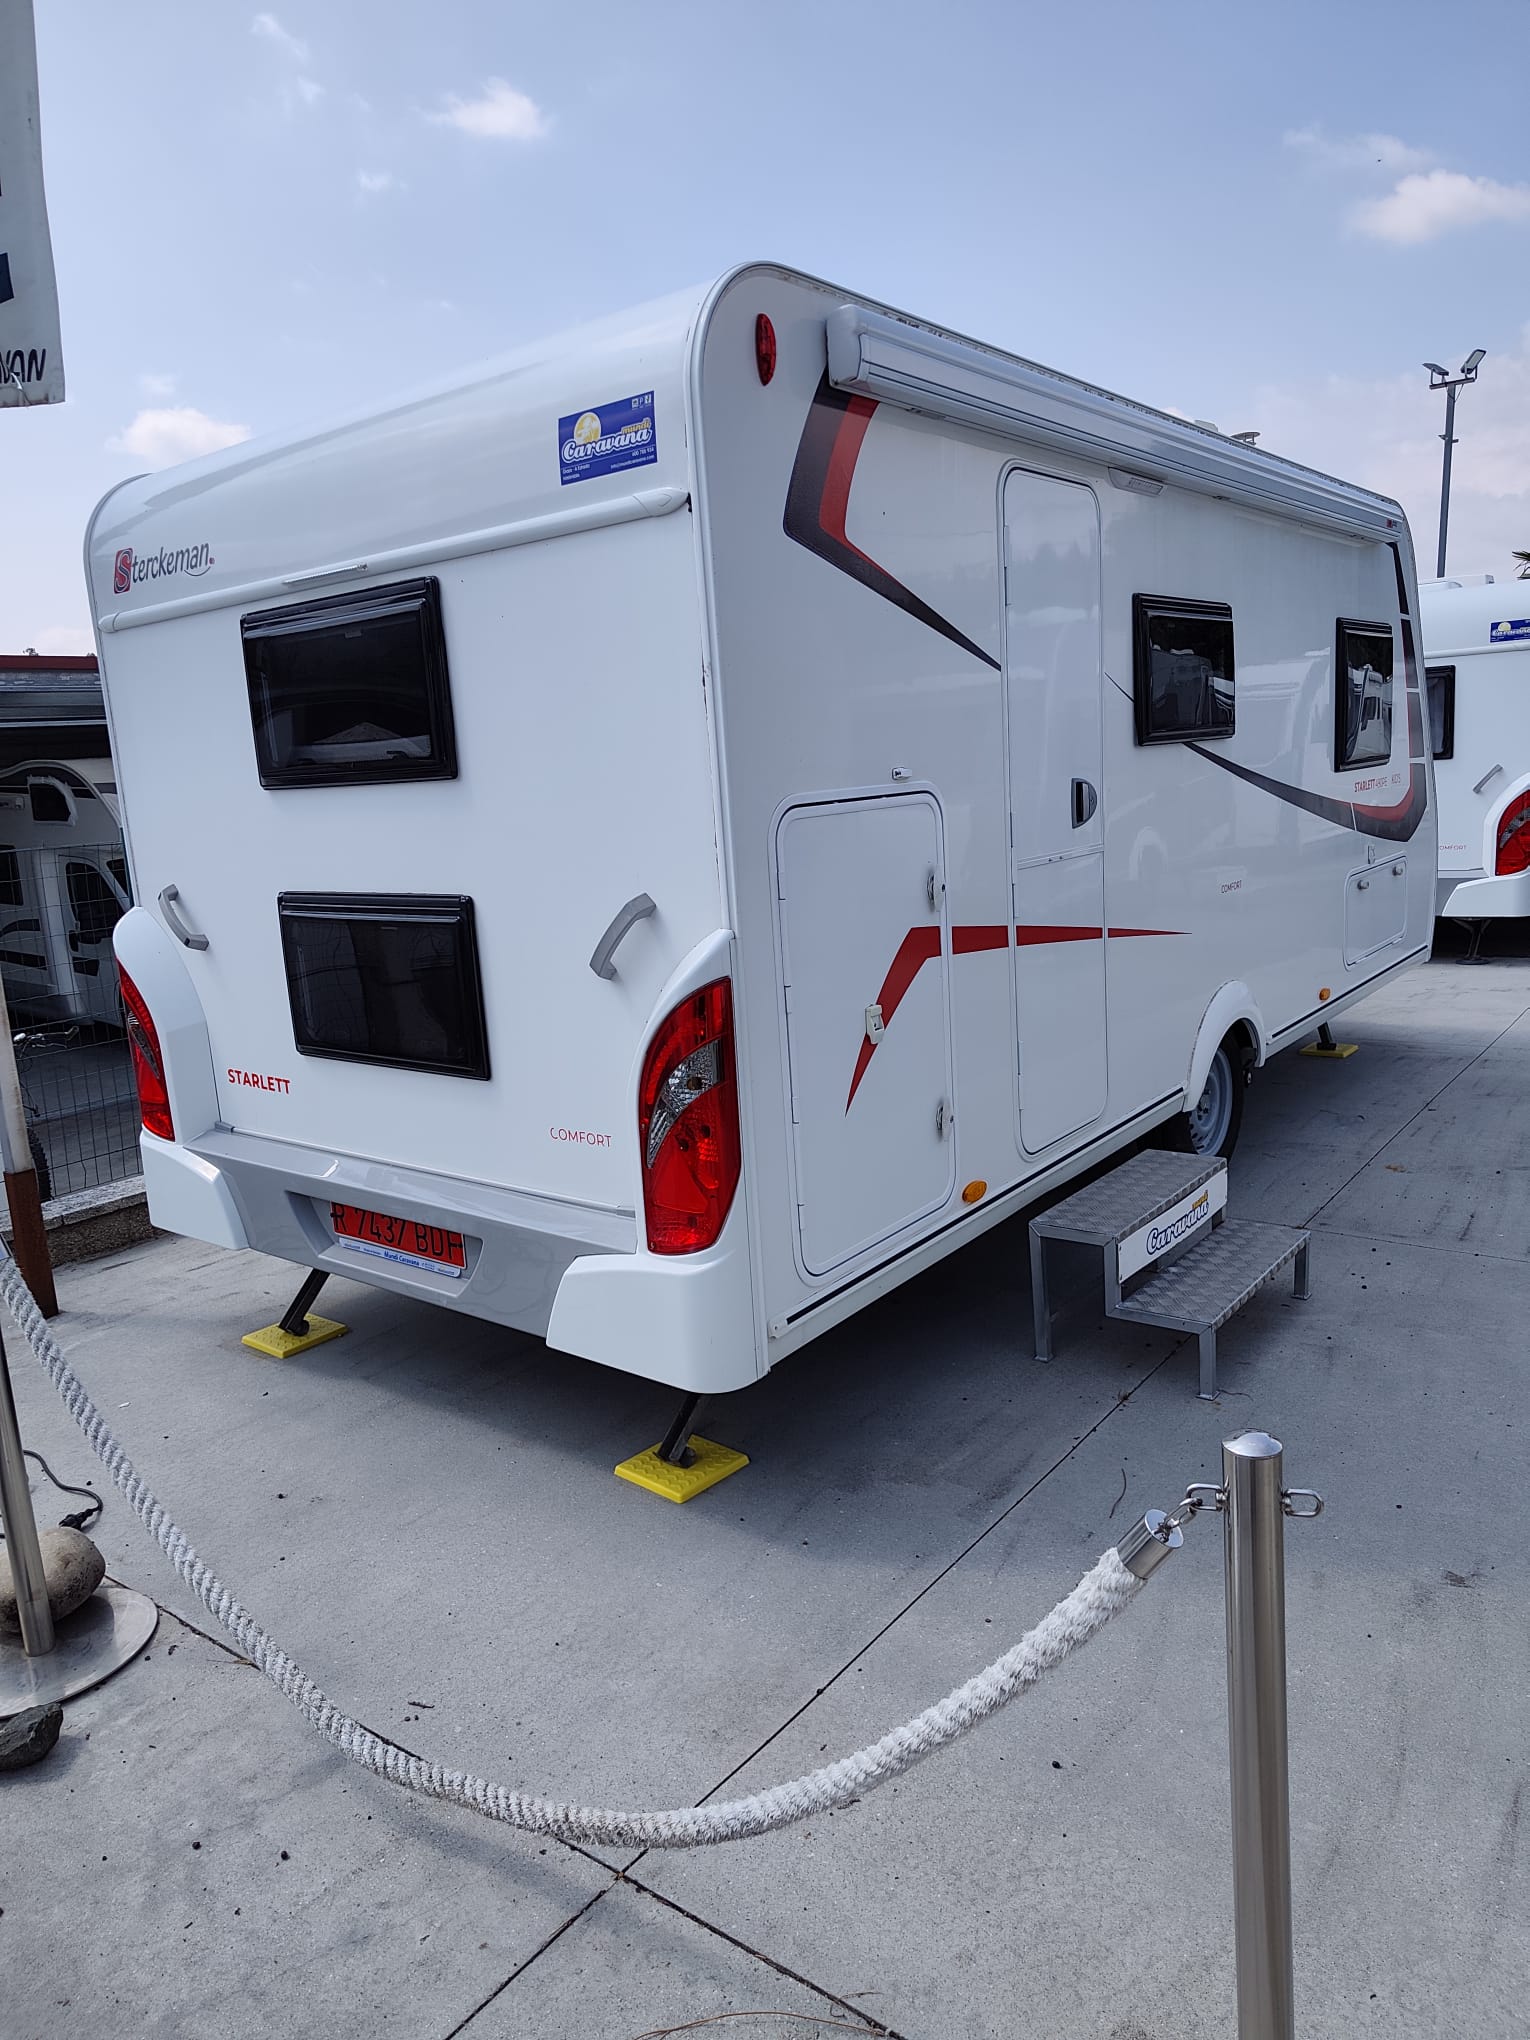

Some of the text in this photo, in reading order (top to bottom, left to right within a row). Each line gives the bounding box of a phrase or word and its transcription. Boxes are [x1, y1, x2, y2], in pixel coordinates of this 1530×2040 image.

[0, 349, 46, 384] VAN
[562, 429, 653, 463] Caravana
[114, 543, 210, 594] Sterckeman
[1354, 778, 1376, 793] STARLETT
[227, 1068, 291, 1095] STARLETT
[550, 1127, 612, 1148] COMFORT
[332, 1202, 348, 1233] R
[353, 1207, 408, 1247] 7437
[1146, 1201, 1210, 1255] Caravana
[399, 1255, 420, 1266] Caravana
